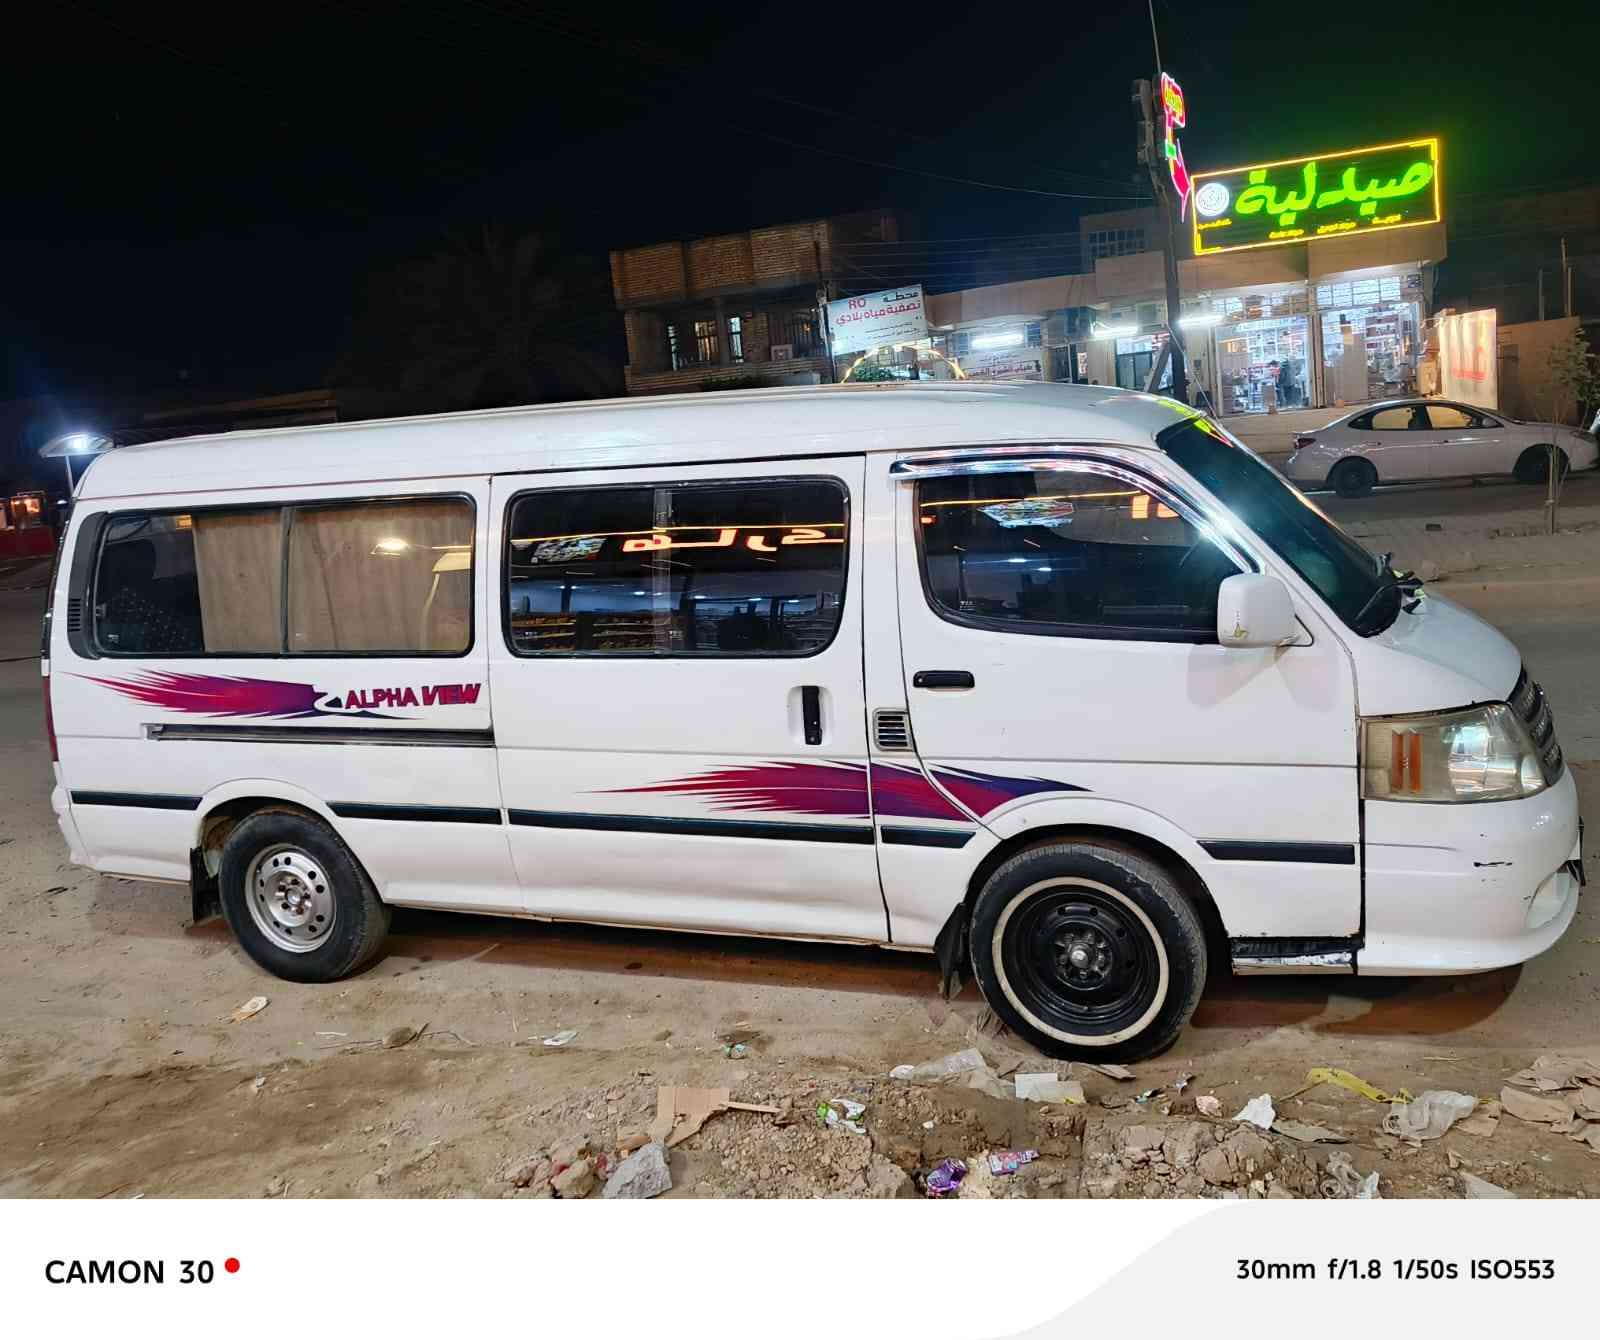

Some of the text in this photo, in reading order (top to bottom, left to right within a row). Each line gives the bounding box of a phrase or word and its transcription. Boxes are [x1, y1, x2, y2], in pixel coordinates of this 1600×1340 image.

[1235, 160, 1434, 226] صيدلية
[883, 290, 919, 303] محطة
[848, 298, 867, 310] RO
[863, 309, 886, 320] مياه
[345, 683, 482, 709] ALPHA VIEW
